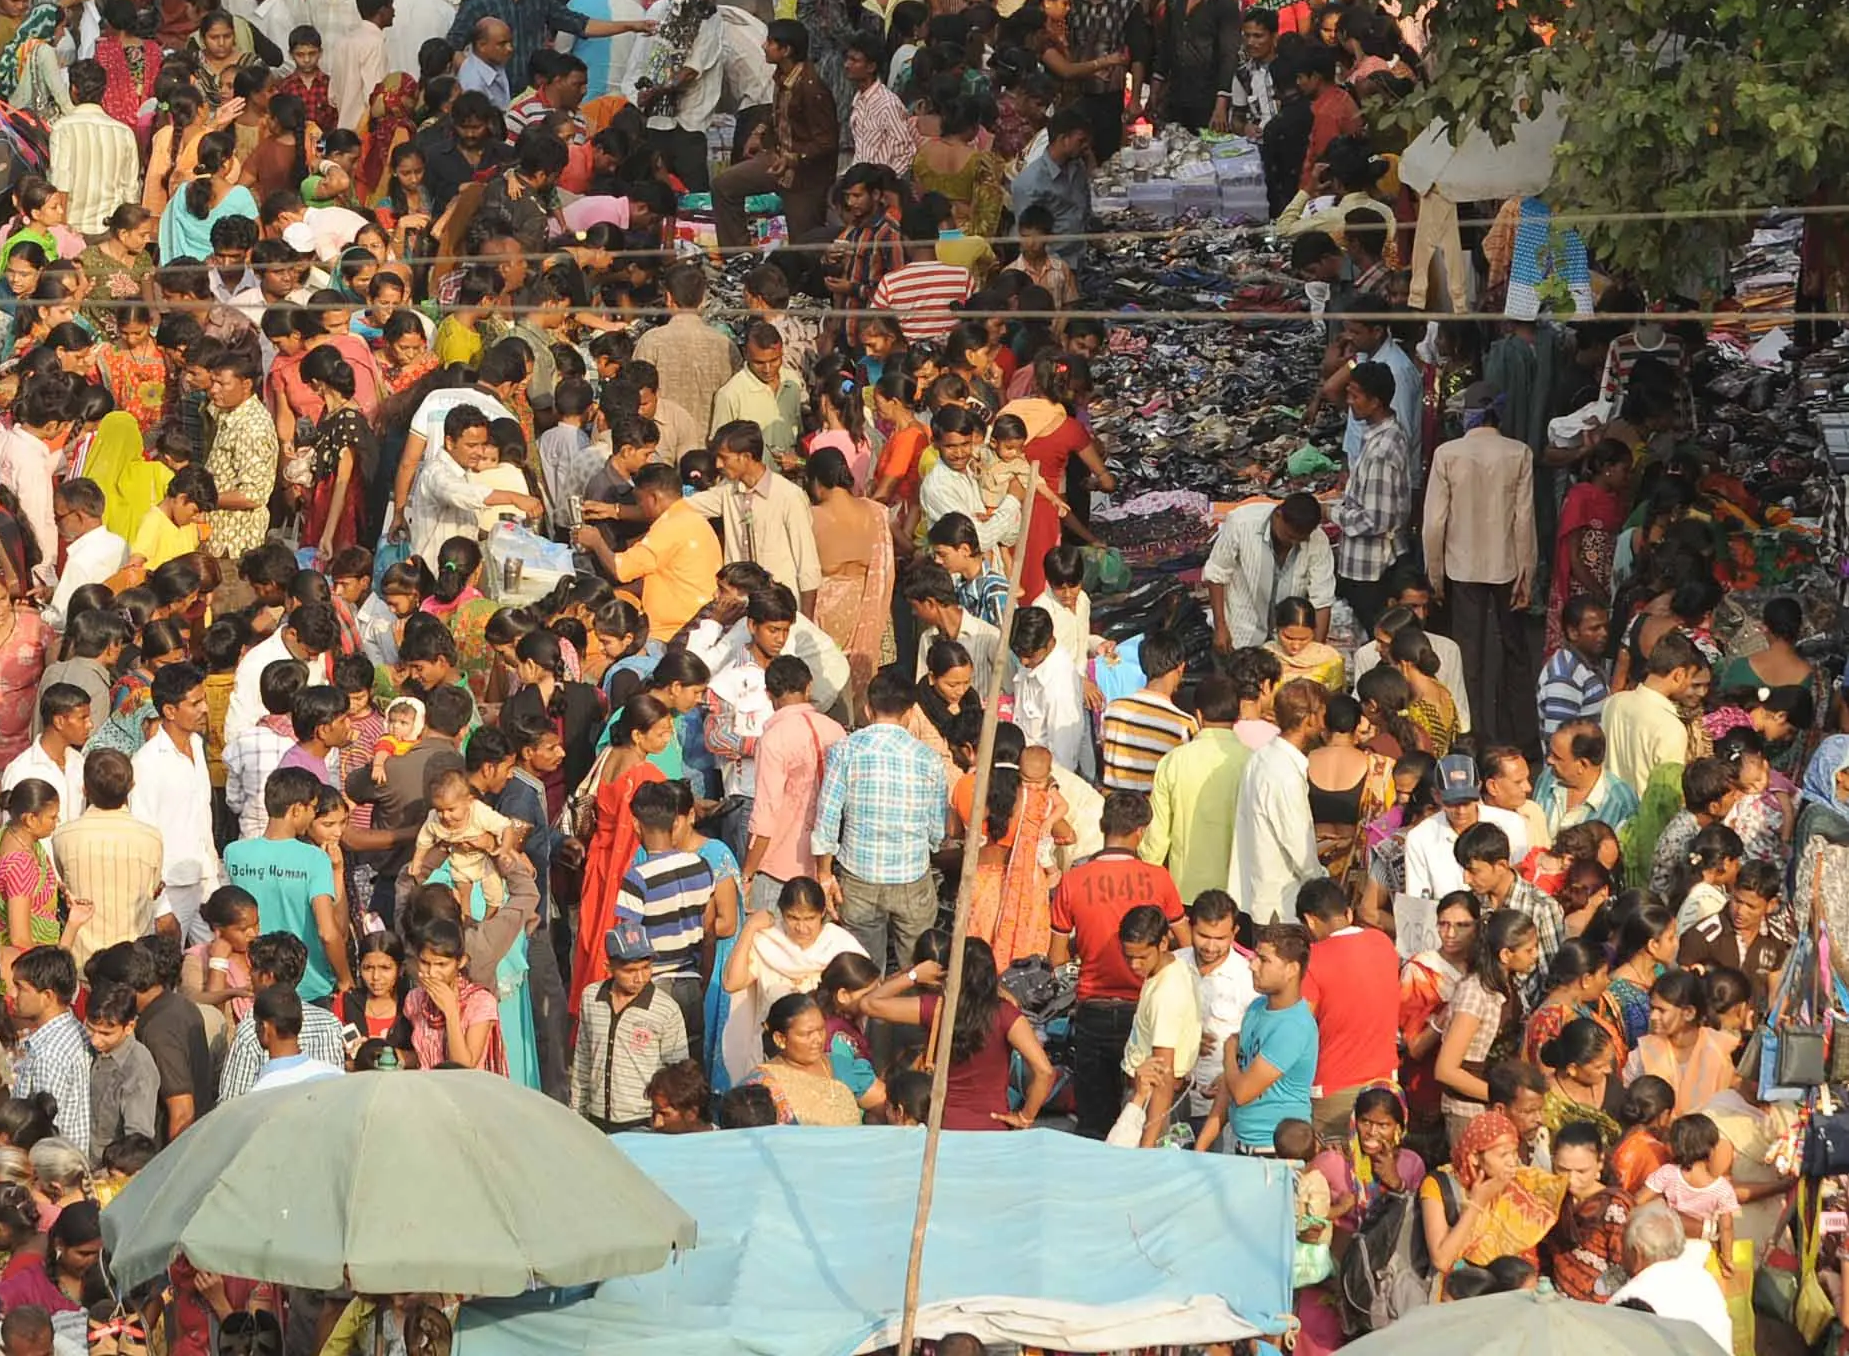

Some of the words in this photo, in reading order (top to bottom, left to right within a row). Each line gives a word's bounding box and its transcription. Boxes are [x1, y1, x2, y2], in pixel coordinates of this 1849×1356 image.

[231, 863, 265, 880] Being
[268, 863, 309, 880] Human
[1083, 872, 1155, 906] 1945
